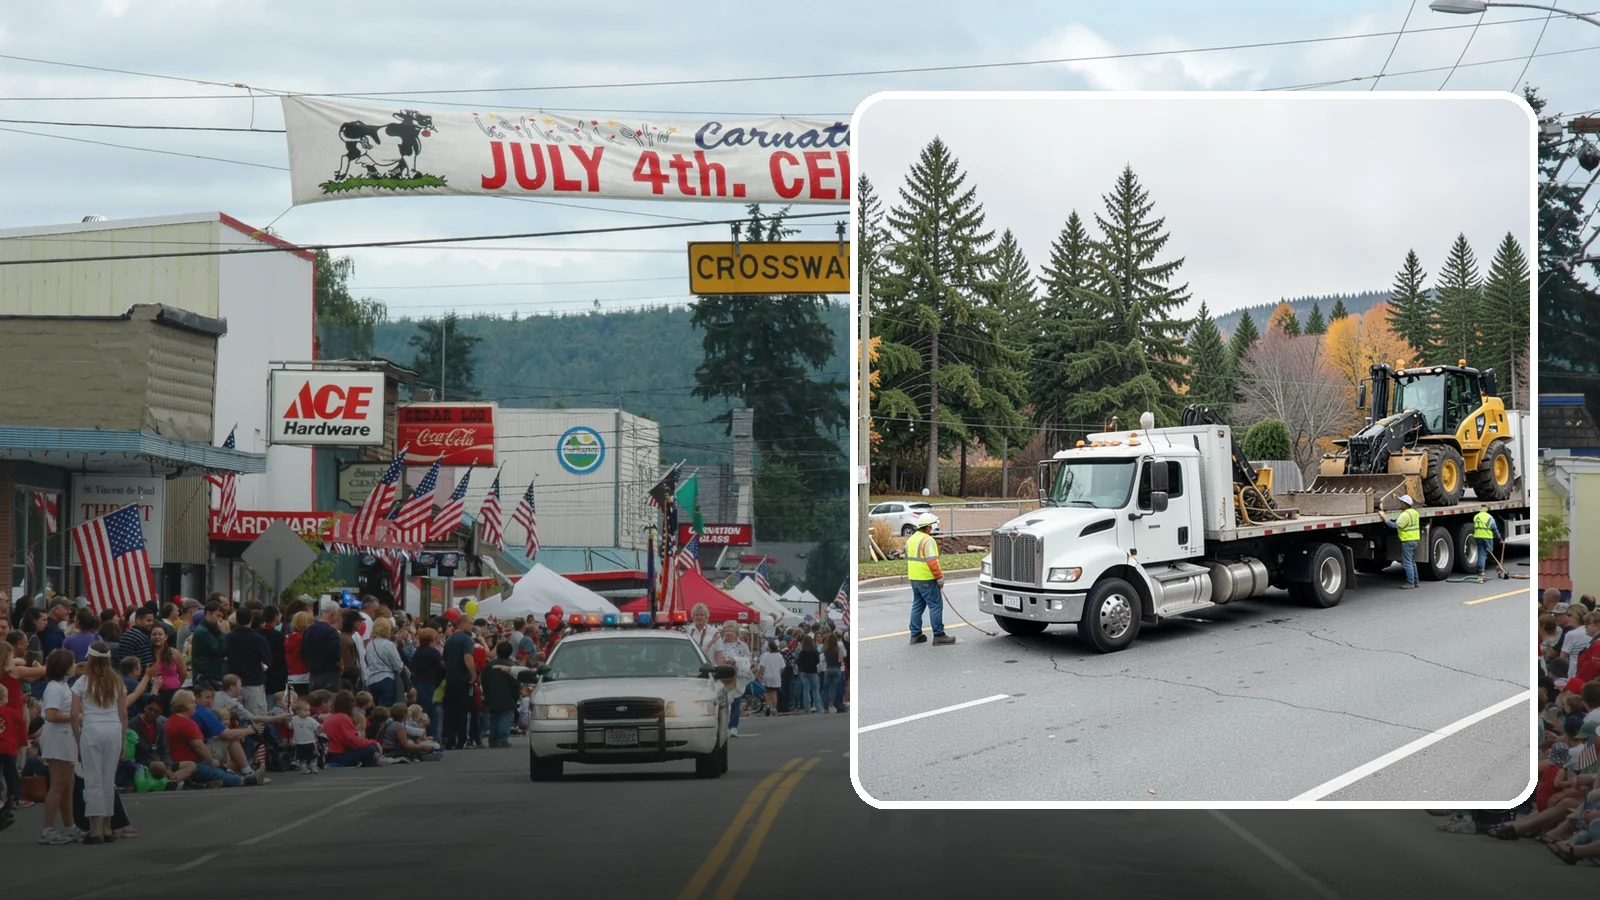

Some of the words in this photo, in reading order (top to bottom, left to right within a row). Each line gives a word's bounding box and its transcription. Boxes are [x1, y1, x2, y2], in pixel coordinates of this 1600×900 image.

[695, 121, 850, 150] Carnat
[481, 141, 604, 192] JULY
[632, 150, 746, 198] 4th.
[697, 254, 850, 280] CROSSWA
[282, 380, 374, 420] ACE
[283, 421, 371, 437] Hardware
[353, 467, 387, 479] Simpl
[95, 485, 124, 495] Vincent
[126, 486, 136, 495] de
[137, 486, 155, 495] Paul
[688, 526, 742, 535] CRNATION
[699, 535, 730, 543] GLASS
